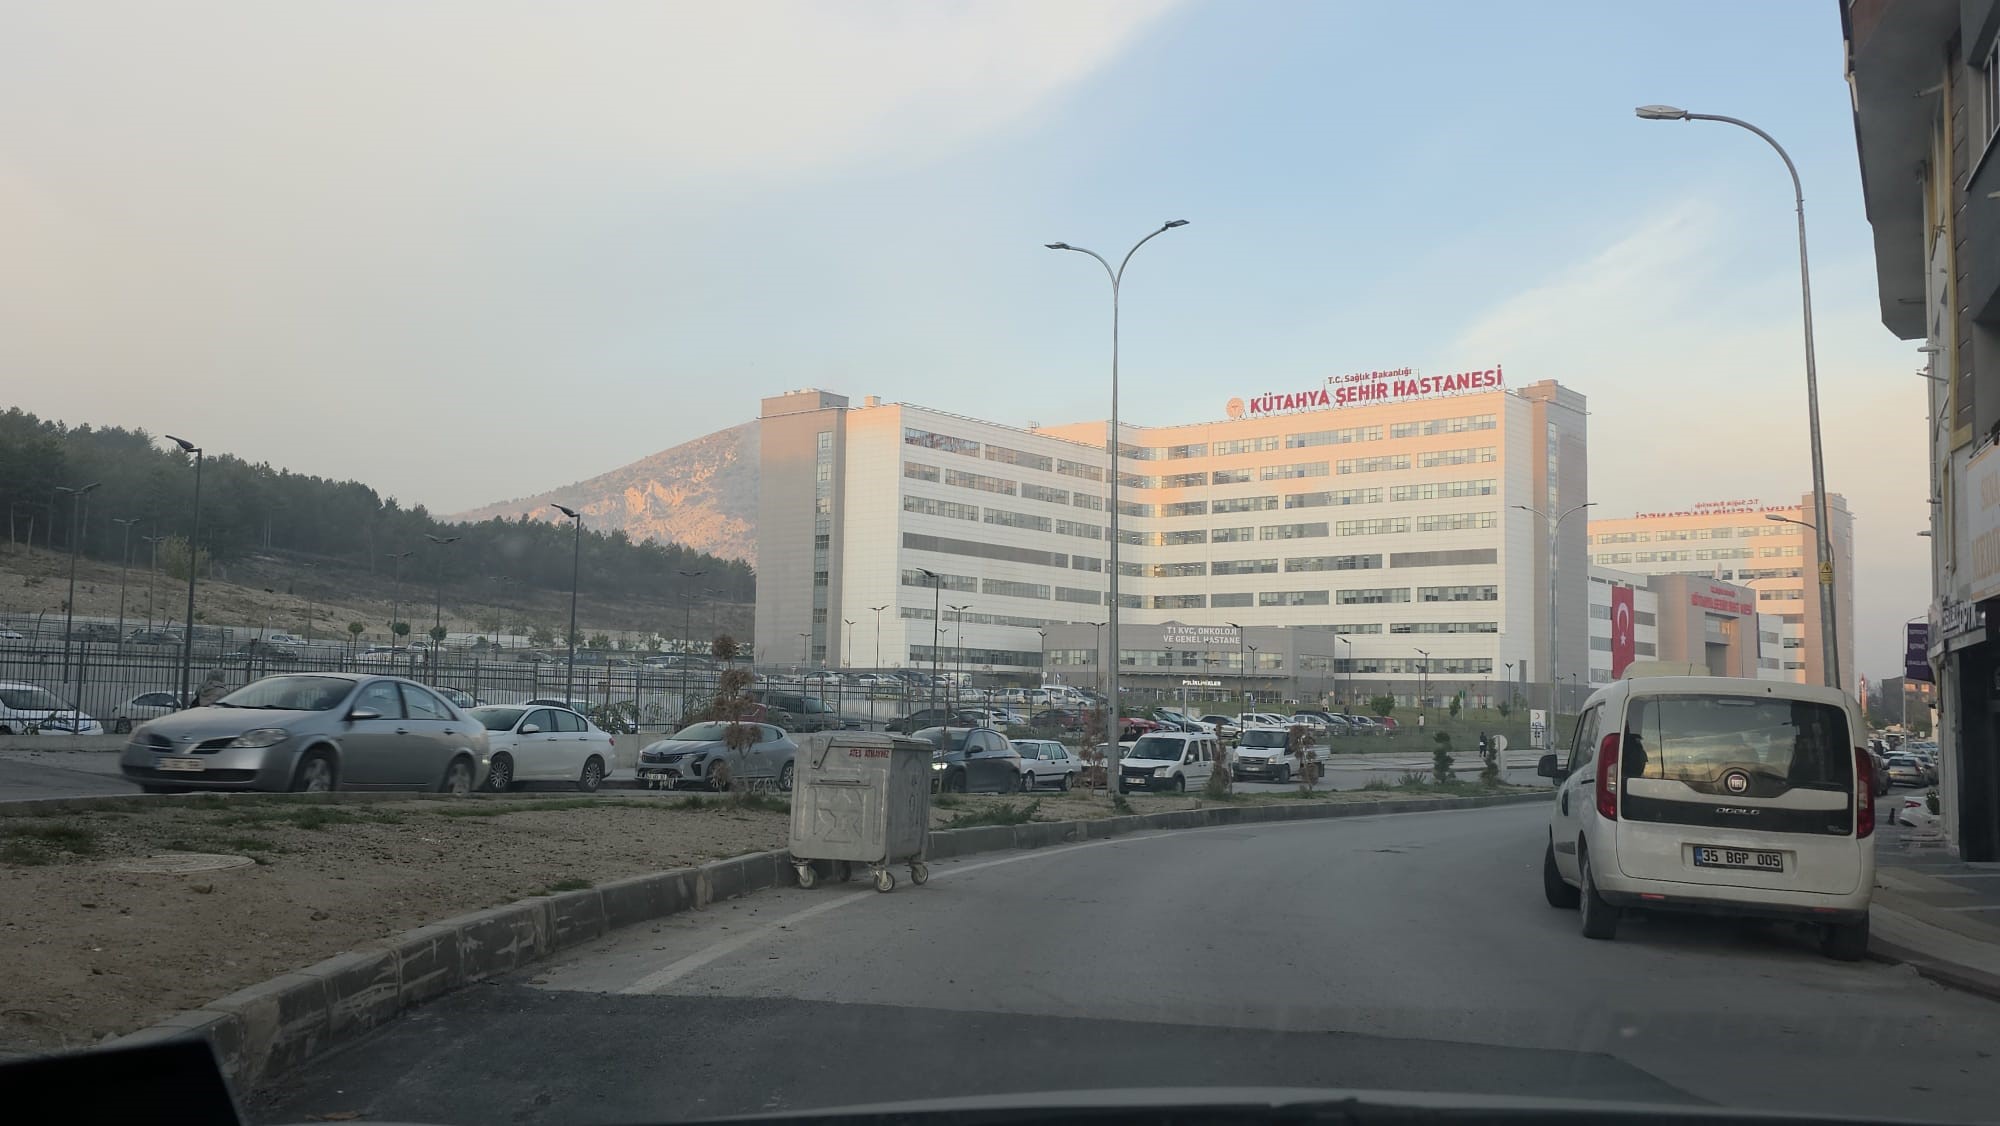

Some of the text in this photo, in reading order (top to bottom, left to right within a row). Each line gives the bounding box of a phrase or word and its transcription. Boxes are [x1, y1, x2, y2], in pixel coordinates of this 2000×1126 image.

[1250, 364, 1503, 414] KÜTAHYA ŞEHİR HASTANESİ
[1163, 635, 1241, 644] VE GENEL HASTANE
[1703, 849, 1719, 862] 35
[1726, 851, 1749, 864] BGP
[1757, 854, 1780, 867] 005
